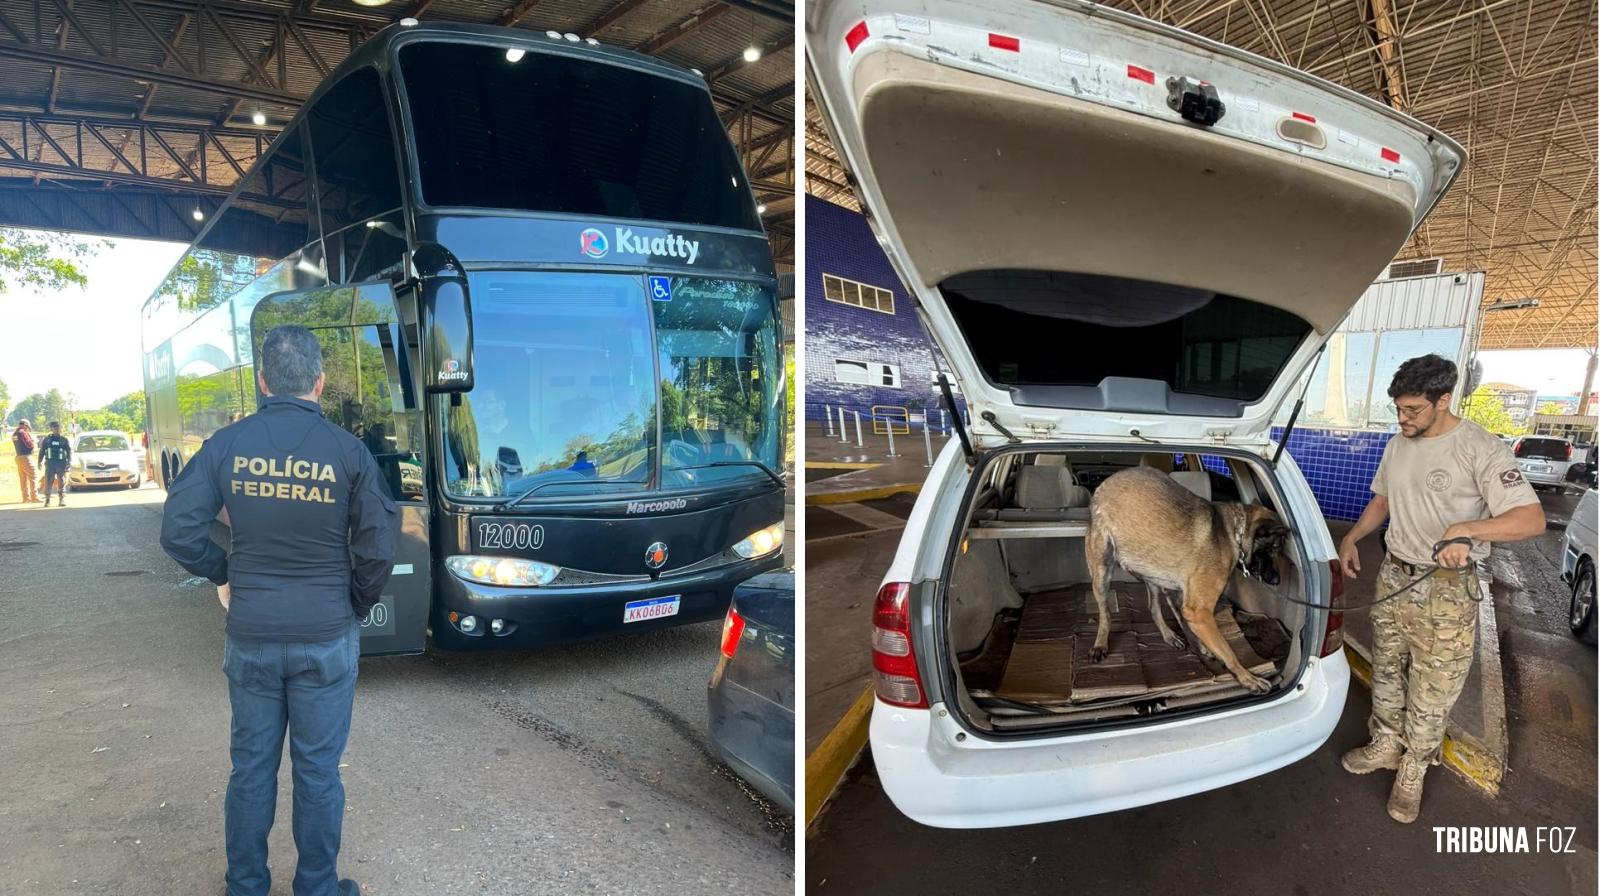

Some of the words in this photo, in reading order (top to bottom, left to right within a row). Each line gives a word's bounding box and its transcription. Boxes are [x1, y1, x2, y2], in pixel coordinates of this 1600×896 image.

[615, 227, 699, 264] Kuatty
[438, 371, 468, 381] Kuatty
[233, 455, 336, 482] POLÍCIA
[231, 480, 336, 503] FEDERAL
[626, 498, 687, 514] Marcopolo
[479, 523, 544, 549] 12000
